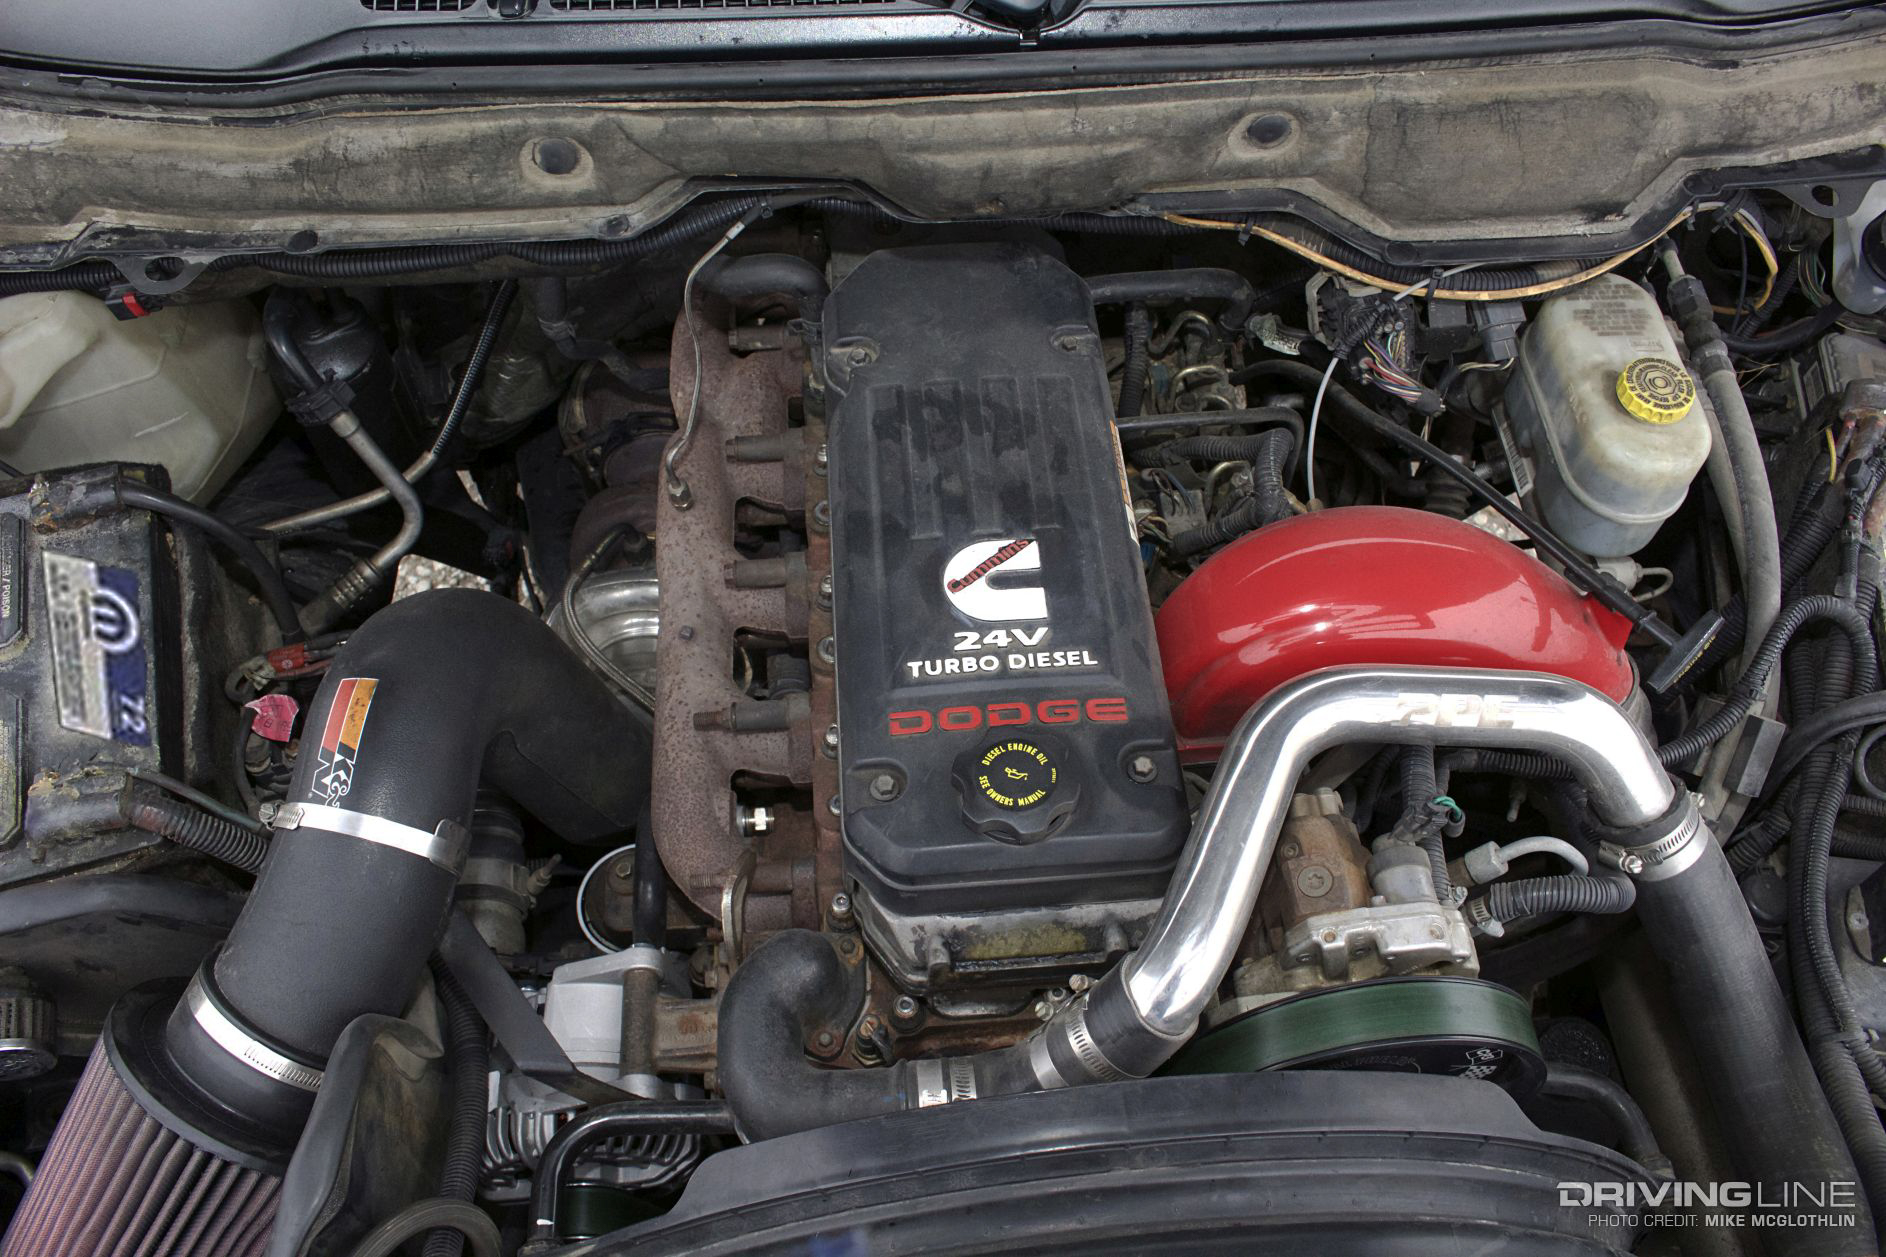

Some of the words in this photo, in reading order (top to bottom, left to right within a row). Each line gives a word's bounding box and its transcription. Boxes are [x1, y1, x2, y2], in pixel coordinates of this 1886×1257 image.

[947, 539, 1030, 593] Cummins
[2, 584, 12, 618] POISON
[953, 627, 1049, 651] 24V
[907, 655, 999, 678] TURBO
[1008, 650, 1098, 670] DIESEL
[120, 696, 146, 733] 72
[888, 698, 1128, 736] DODGE
[981, 745, 1006, 766] DIESEL
[1007, 743, 1038, 756] ENGINE
[1036, 753, 1048, 765] OIL
[979, 775, 991, 789] SEE
[986, 788, 1014, 806] OWNERS
[1018, 789, 1046, 806] MANUAL
